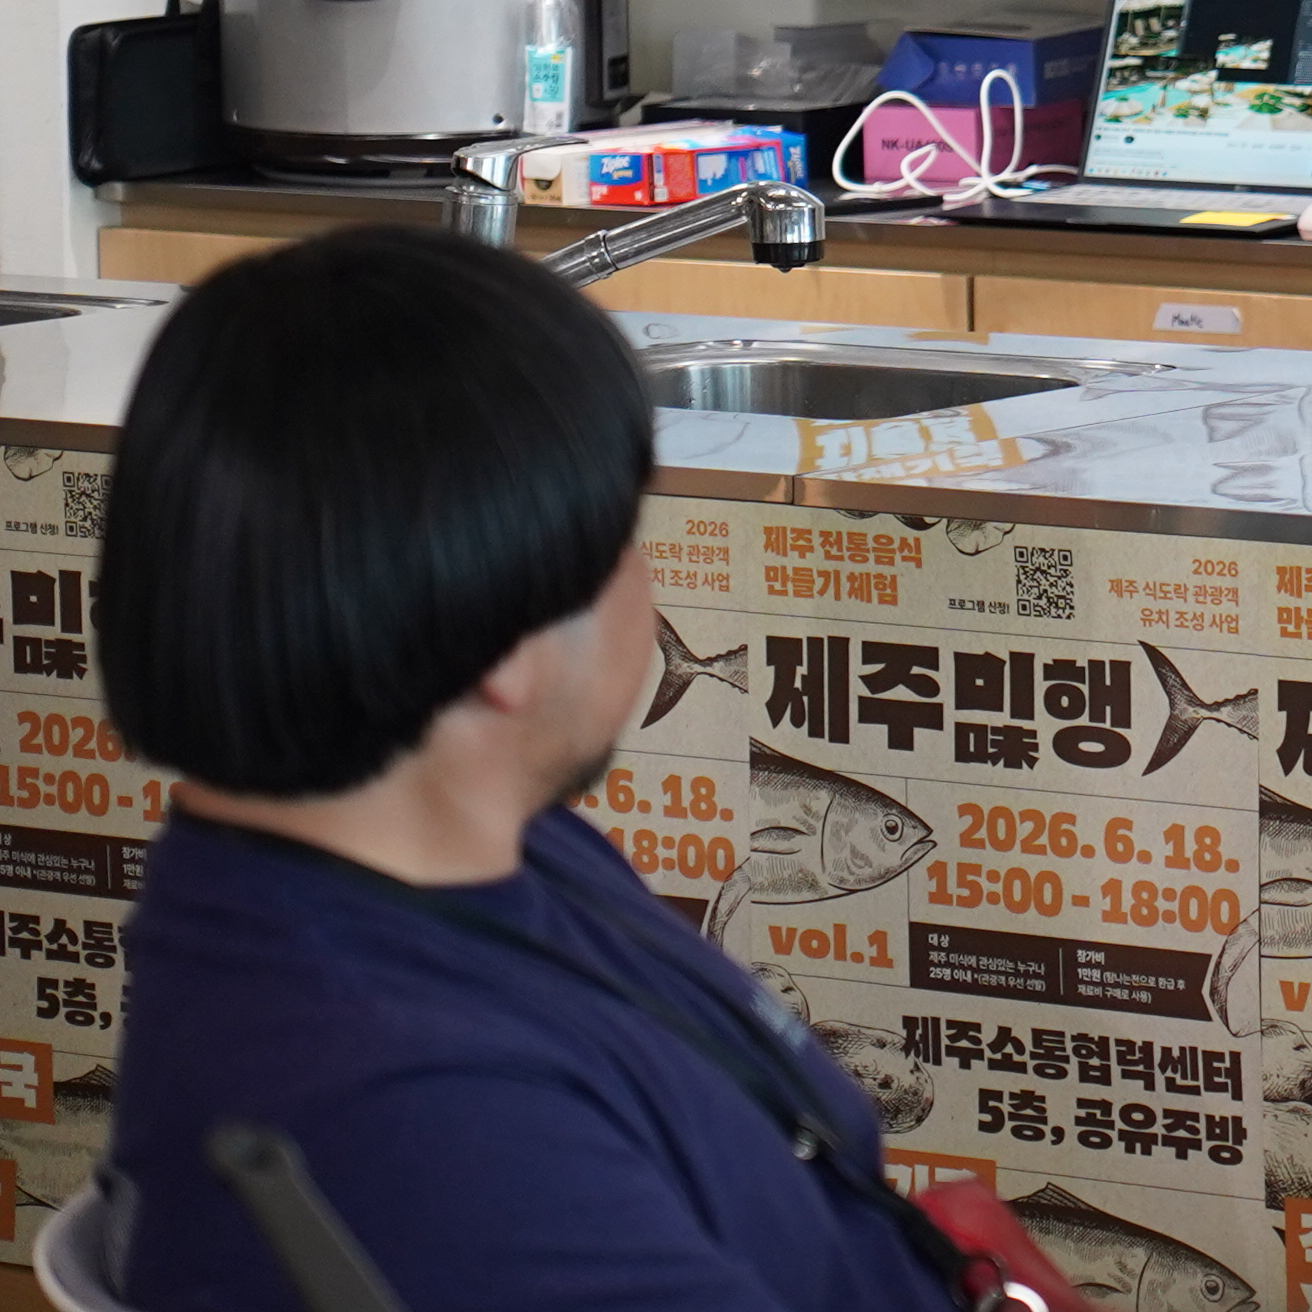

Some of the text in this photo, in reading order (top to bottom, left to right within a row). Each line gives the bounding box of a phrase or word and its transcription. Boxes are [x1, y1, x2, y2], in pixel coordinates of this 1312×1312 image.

[5, 520, 38, 534] 프로그램
[685, 519, 729, 537] 2026
[640, 540, 730, 566] 식도락 관광객
[763, 525, 923, 569] 제주 전통음식
[1192, 558, 1239, 577] 2026
[669, 569, 698, 590] 조성
[702, 572, 730, 592] 사업
[764, 565, 899, 607] 만들기 체험
[1108, 578, 1240, 607] 제주 식도락 관광객
[948, 598, 986, 613] 프로그램
[1139, 609, 1240, 635] 유치 조성 사업
[768, 924, 894, 969] vol.1
[1077, 949, 1105, 965] 참가비
[929, 967, 951, 981] 25명
[953, 968, 972, 984] 이내
[949, 953, 977, 969] 미식에
[978, 956, 1015, 972] 관심있는
[1017, 960, 1045, 976] 누구나
[1077, 968, 1101, 983] 1만원
[902, 1015, 1243, 1102] 제주소통협력센터
[1074, 1096, 1247, 1167] 공유주방
